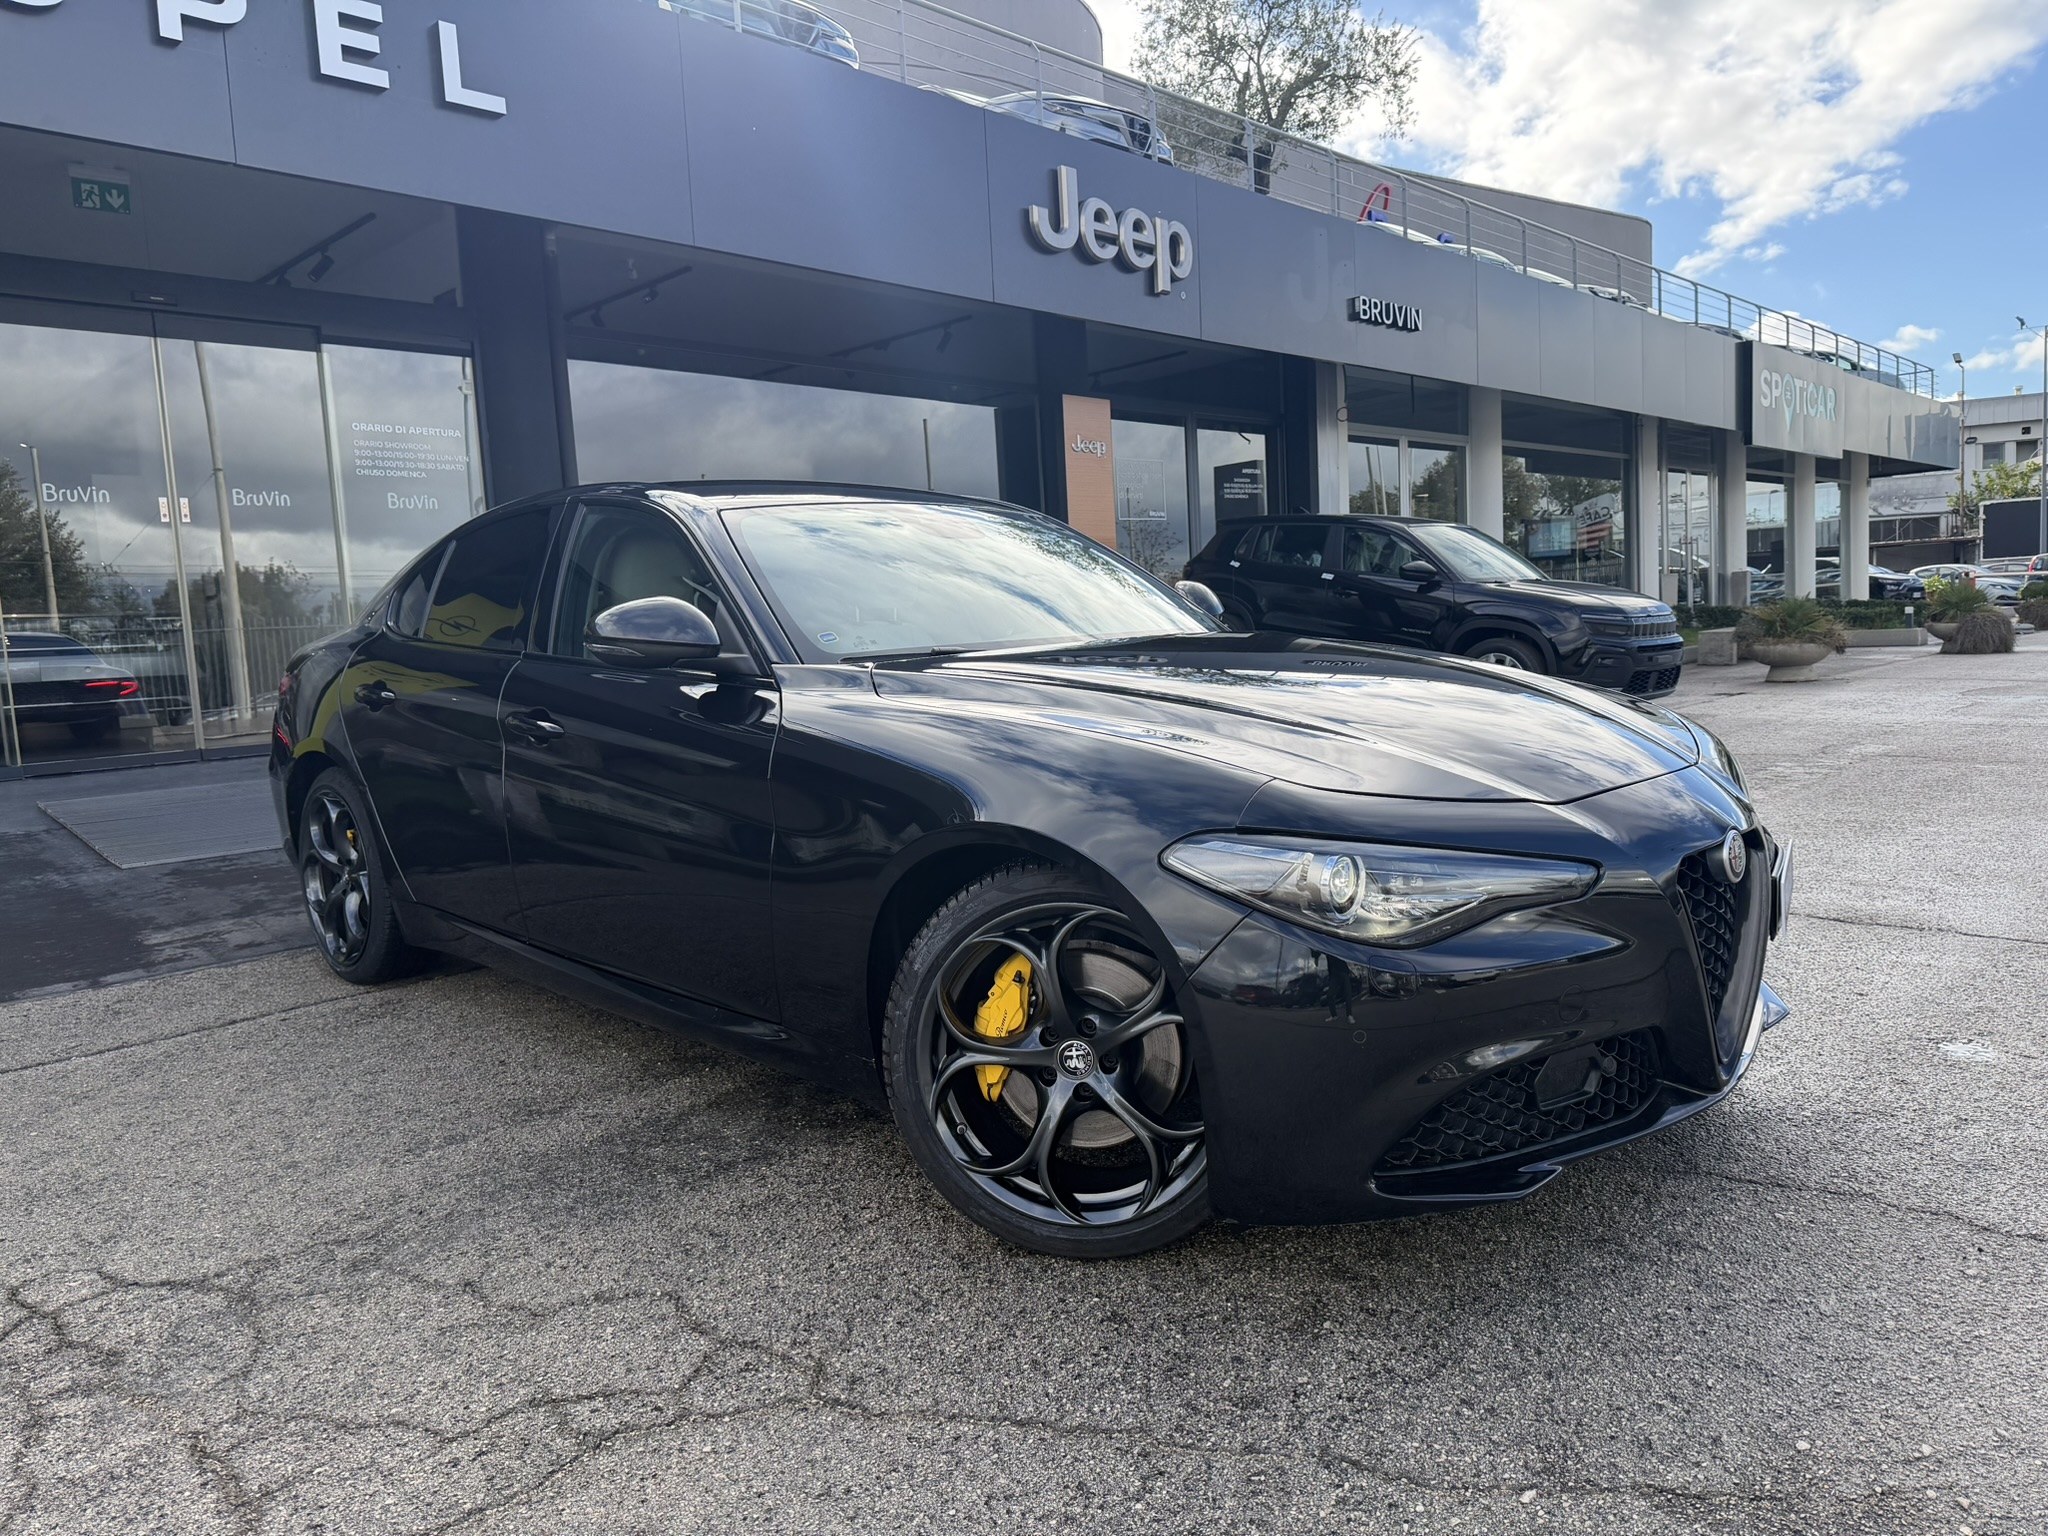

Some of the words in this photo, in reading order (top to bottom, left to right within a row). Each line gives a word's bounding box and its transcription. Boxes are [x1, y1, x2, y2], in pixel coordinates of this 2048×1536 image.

[0, 0, 507, 115] EL
[1028, 165, 1193, 295] Jeep
[1359, 295, 1423, 332] BRUVIN
[351, 422, 393, 433] ORARIO
[395, 425, 406, 434] DI
[408, 426, 462, 438] APERTURA
[353, 439, 384, 448] ORARIO
[384, 441, 431, 451] SHOWROOM
[1071, 434, 1106, 457] Jeep
[355, 468, 386, 477] CHIUSO
[386, 469, 428, 479] DOMENICA
[436, 463, 465, 472] SABATO
[41, 482, 110, 503] BruVin
[231, 488, 291, 507] BruVin
[387, 492, 439, 510] BruVin
